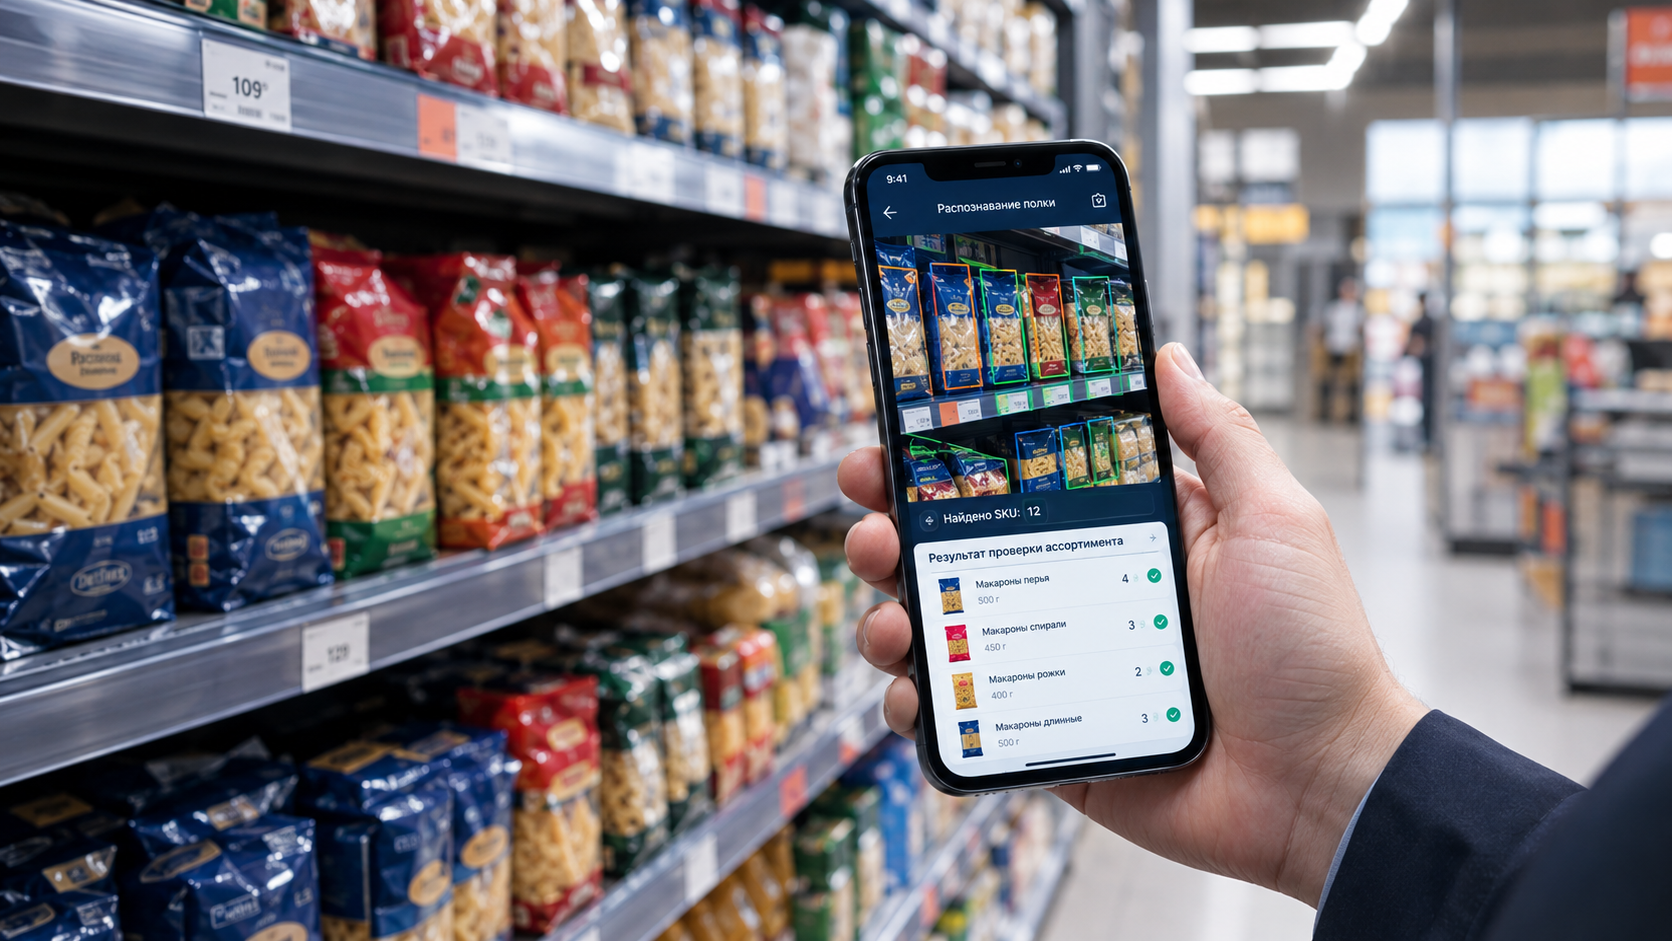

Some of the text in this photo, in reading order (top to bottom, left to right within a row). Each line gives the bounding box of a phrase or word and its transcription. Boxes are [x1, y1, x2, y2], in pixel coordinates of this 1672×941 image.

[886, 174, 908, 184] 9:41
[937, 199, 1056, 214] Распознавание полки
[943, 505, 1041, 525] Найдено SKU: 12
[928, 537, 1124, 564] Результат проверки ассортимента
[976, 575, 1049, 589] Макароны перья
[1121, 573, 1129, 583] 4
[978, 595, 994, 605] 500
[982, 620, 1067, 636] Макароны спирали
[1128, 620, 1136, 630] 3
[984, 642, 1001, 652] 450
[989, 668, 1066, 683] Макароны рожки
[1134, 666, 1142, 677] 2
[991, 690, 1008, 700] 400
[996, 714, 1082, 732] Макароны длинные
[1141, 713, 1149, 723] 3
[998, 738, 1015, 748] 500
